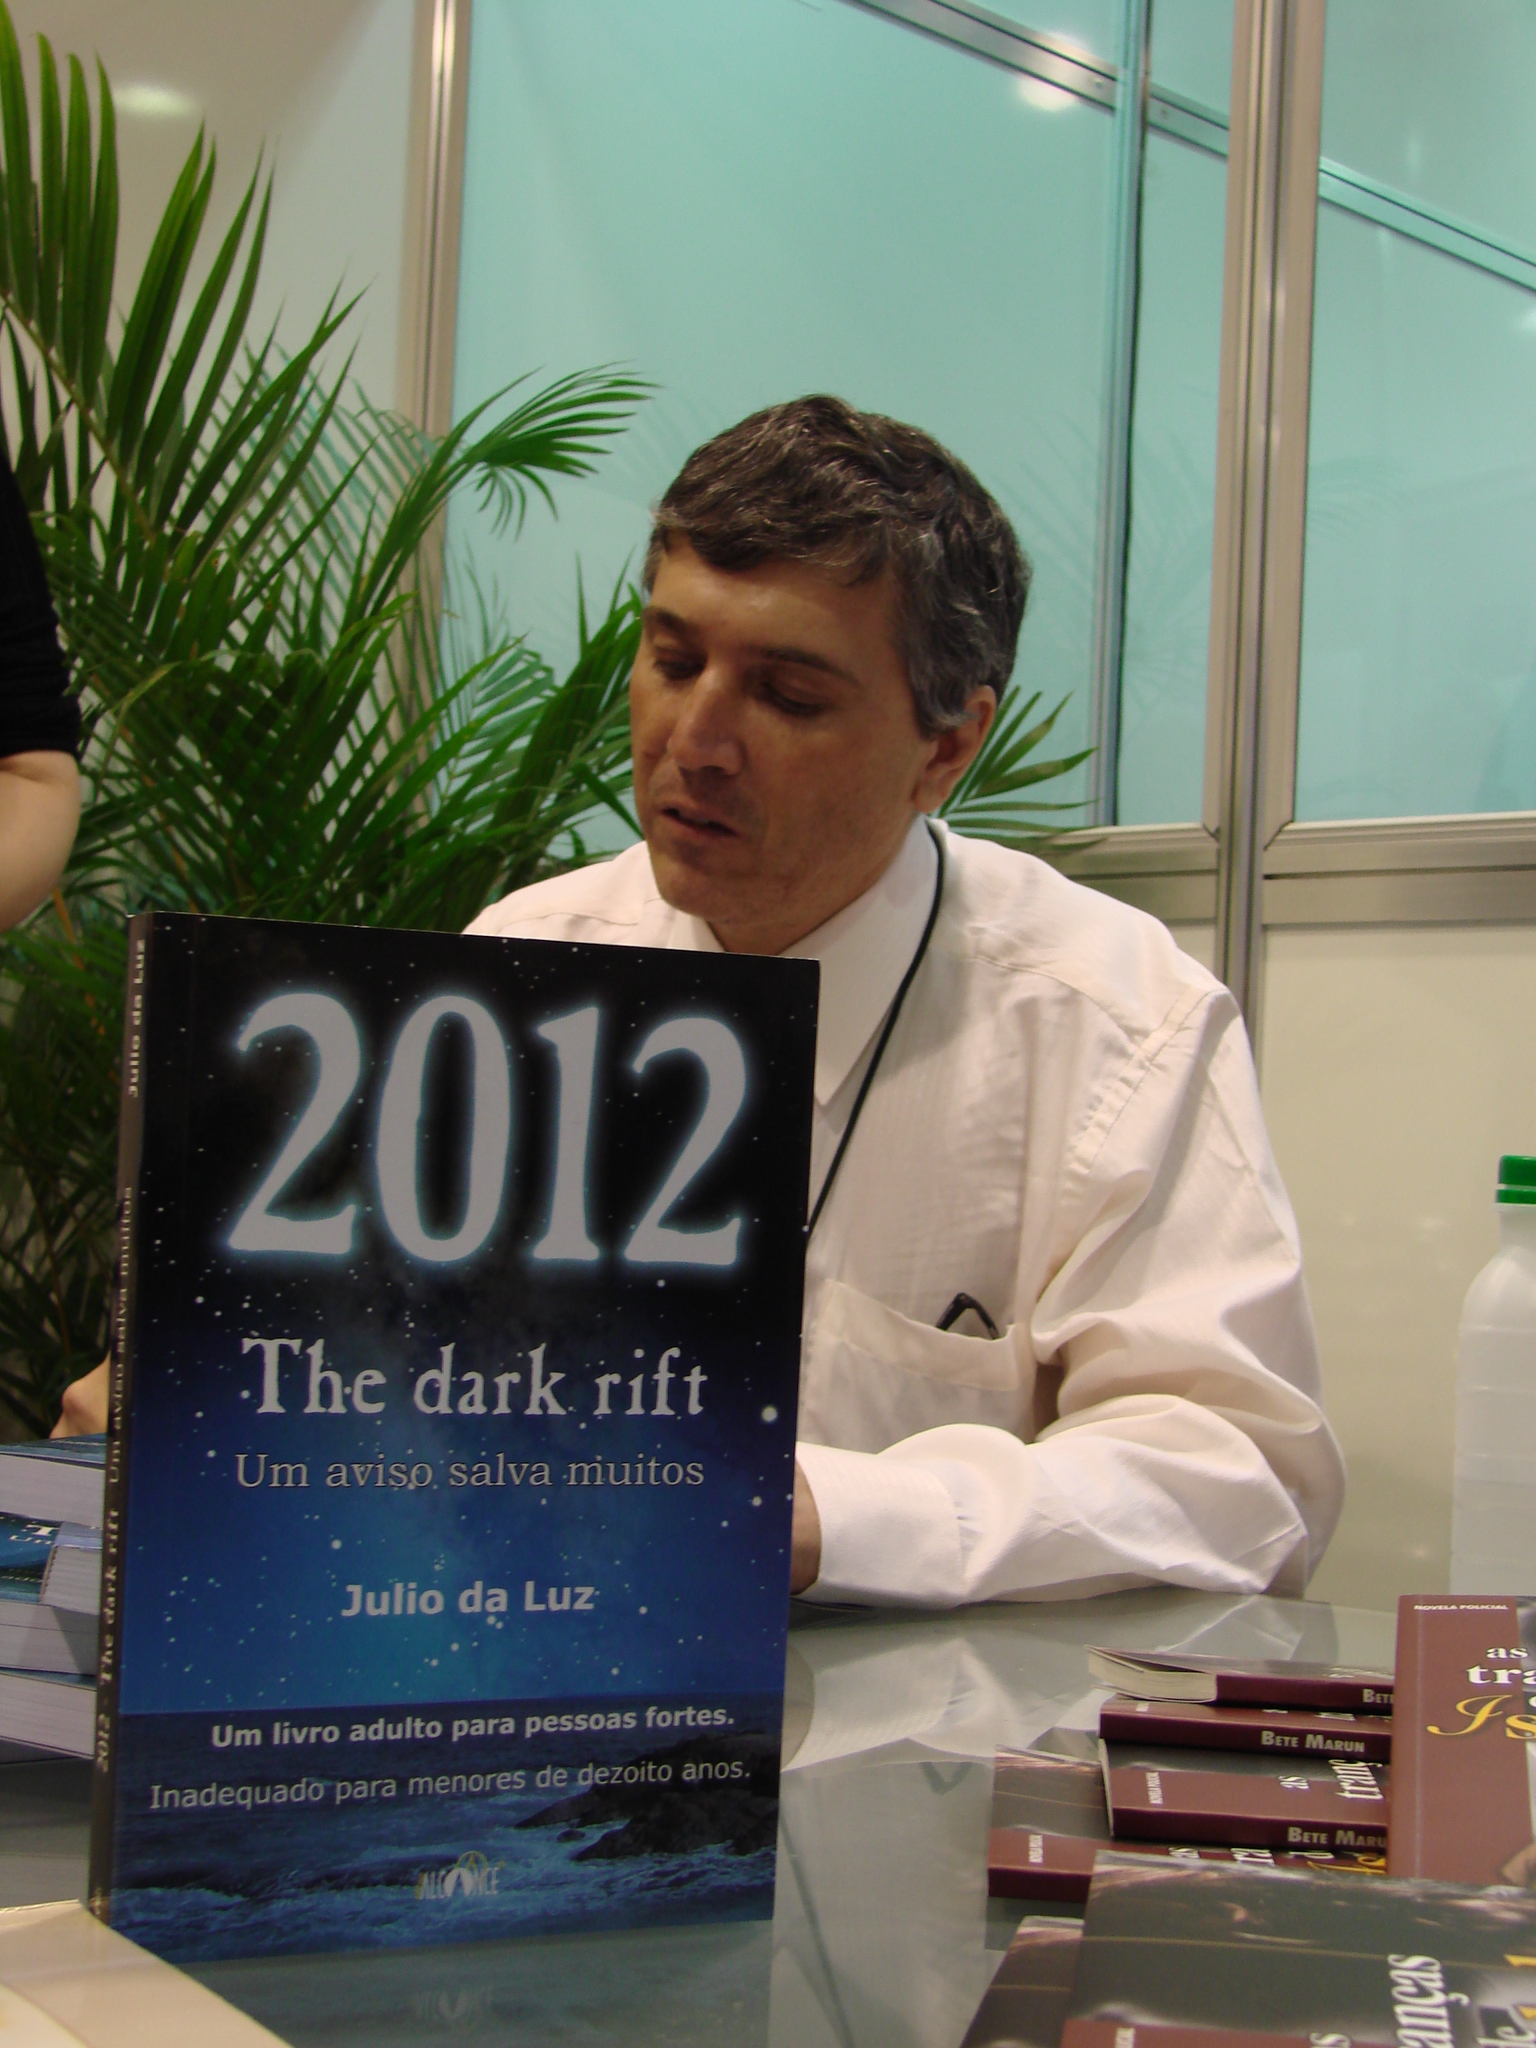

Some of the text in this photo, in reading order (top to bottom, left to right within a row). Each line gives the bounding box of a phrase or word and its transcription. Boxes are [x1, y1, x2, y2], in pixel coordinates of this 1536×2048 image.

[131, 994, 143, 1027] da
[227, 992, 748, 1266] 2012
[241, 1337, 709, 1416] The dark rift
[234, 1452, 705, 1488] Um aviso salva muitos
[340, 1580, 596, 1617] Julio da Luz
[1486, 1647, 1529, 1659] as
[211, 1705, 735, 1748] Um livro adulto para pessoas fortes.
[149, 1759, 752, 1811] Inadequado para menores de dezoito anos.
